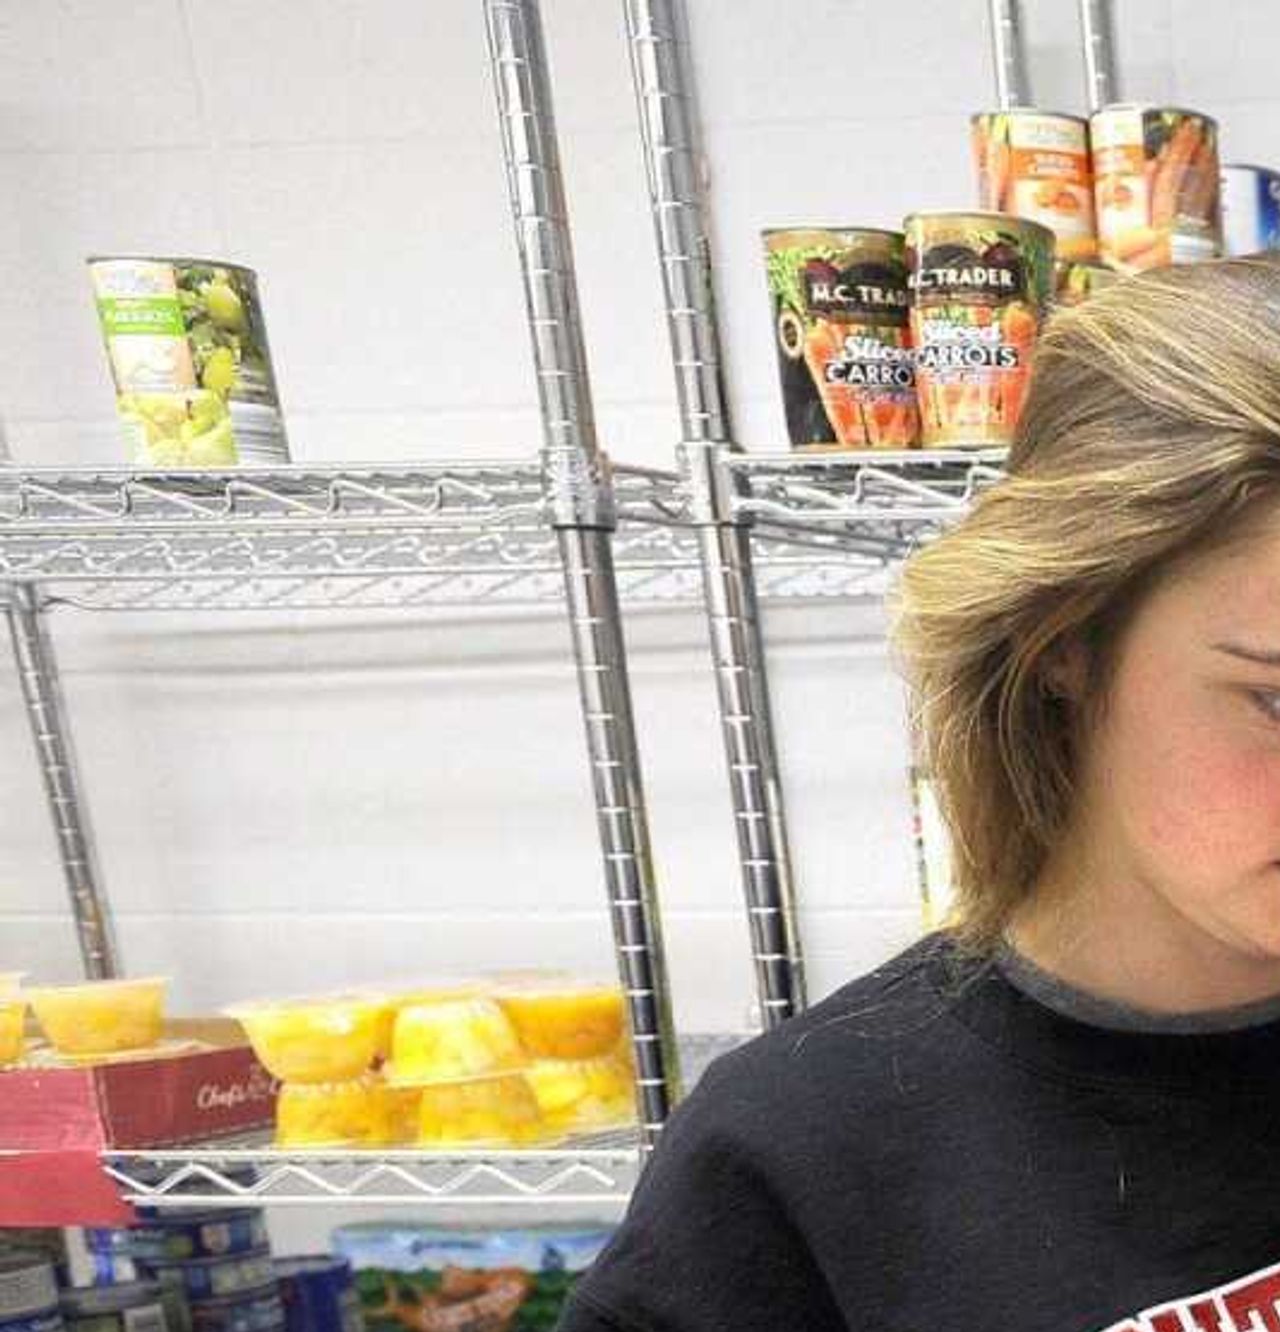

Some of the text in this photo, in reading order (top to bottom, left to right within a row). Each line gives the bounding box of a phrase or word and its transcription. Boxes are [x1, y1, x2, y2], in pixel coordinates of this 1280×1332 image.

[935, 267, 1014, 288] TRADER
[857, 286, 910, 307] TRAD
[922, 319, 1002, 344] Sliced
[844, 336, 910, 360] Slice
[826, 362, 913, 387] CARRO
